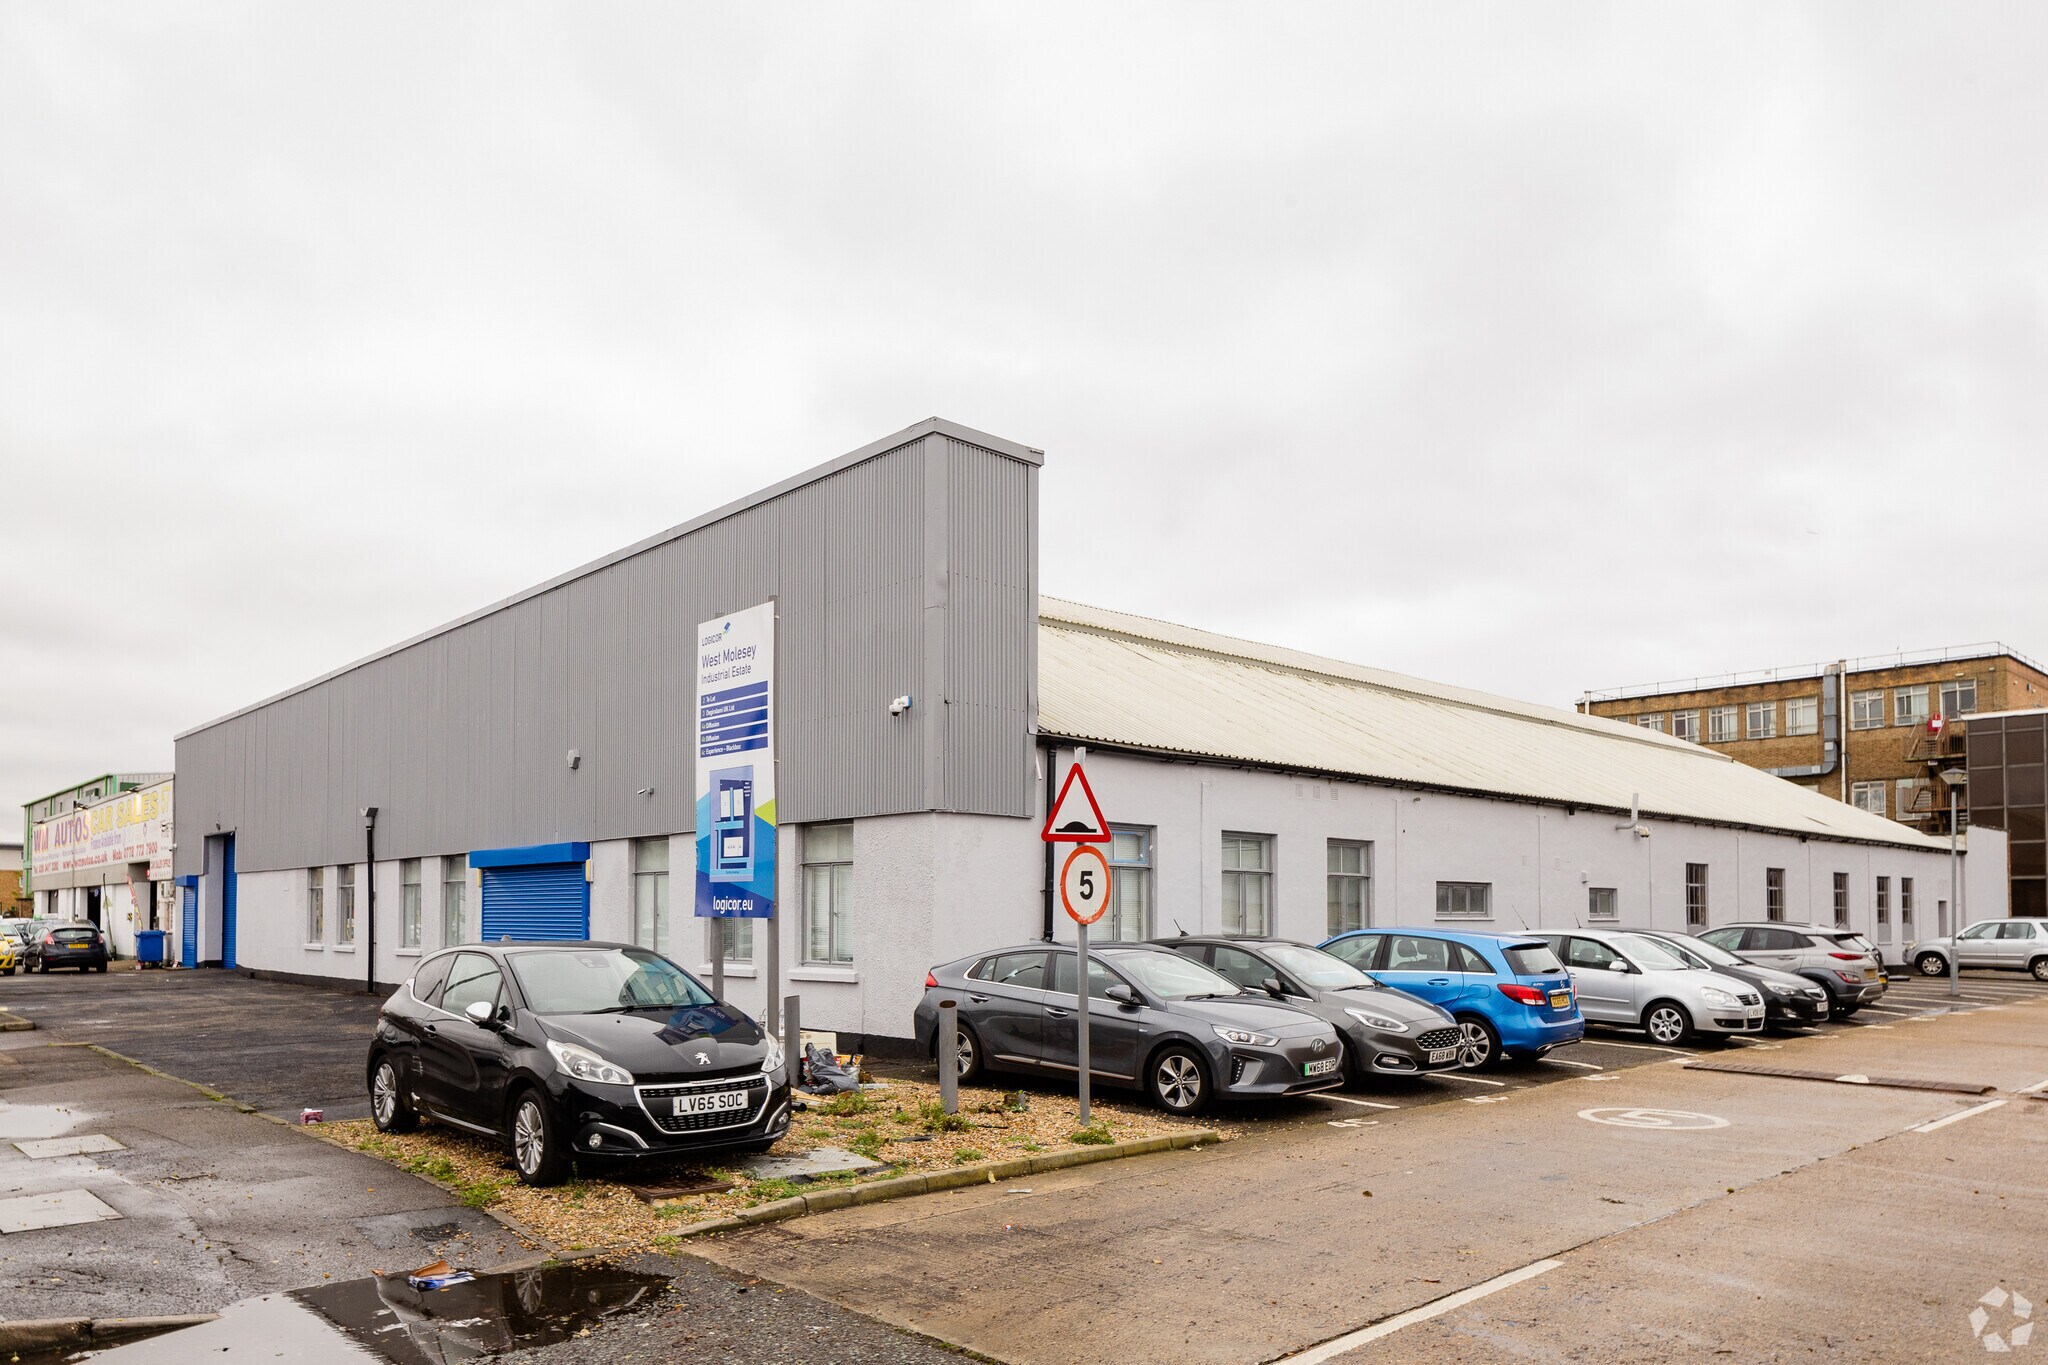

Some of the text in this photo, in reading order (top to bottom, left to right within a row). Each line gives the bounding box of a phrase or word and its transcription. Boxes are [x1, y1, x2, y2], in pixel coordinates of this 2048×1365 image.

[702, 632, 722, 646] LOGICOR
[702, 645, 756, 668] West Molesey
[702, 664, 751, 684] Industrial Estate
[54, 815, 89, 848] AUTOS
[91, 805, 113, 835] CAR
[116, 791, 158, 829] SALES
[1080, 871, 1094, 900] 5
[713, 895, 754, 914] logicor.eu
[679, 1093, 743, 1113] LV65 SOC
